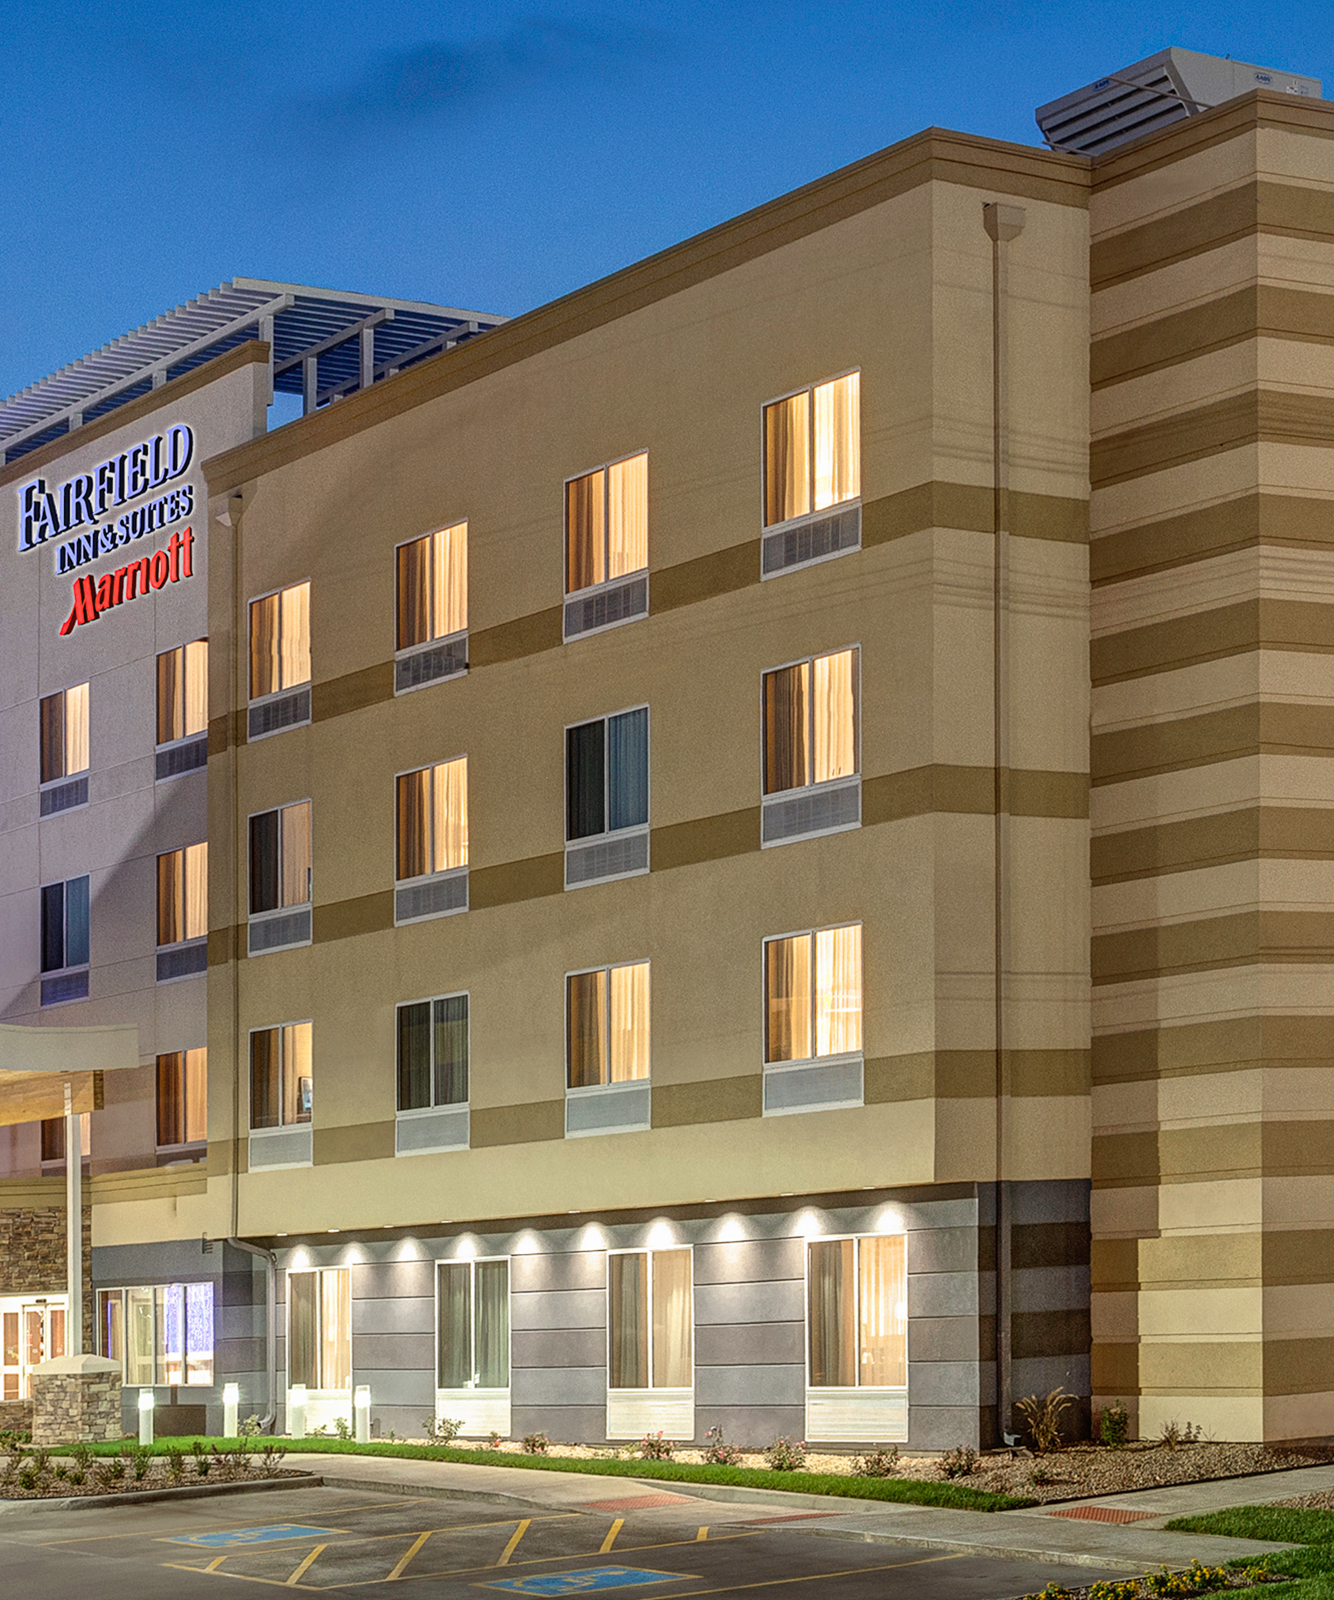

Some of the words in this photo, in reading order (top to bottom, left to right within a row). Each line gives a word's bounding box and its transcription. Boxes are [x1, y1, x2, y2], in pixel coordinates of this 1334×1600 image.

[18, 424, 193, 552] FAIRFIELD
[116, 485, 193, 546] SUITES
[59, 526, 194, 636] Marriott
